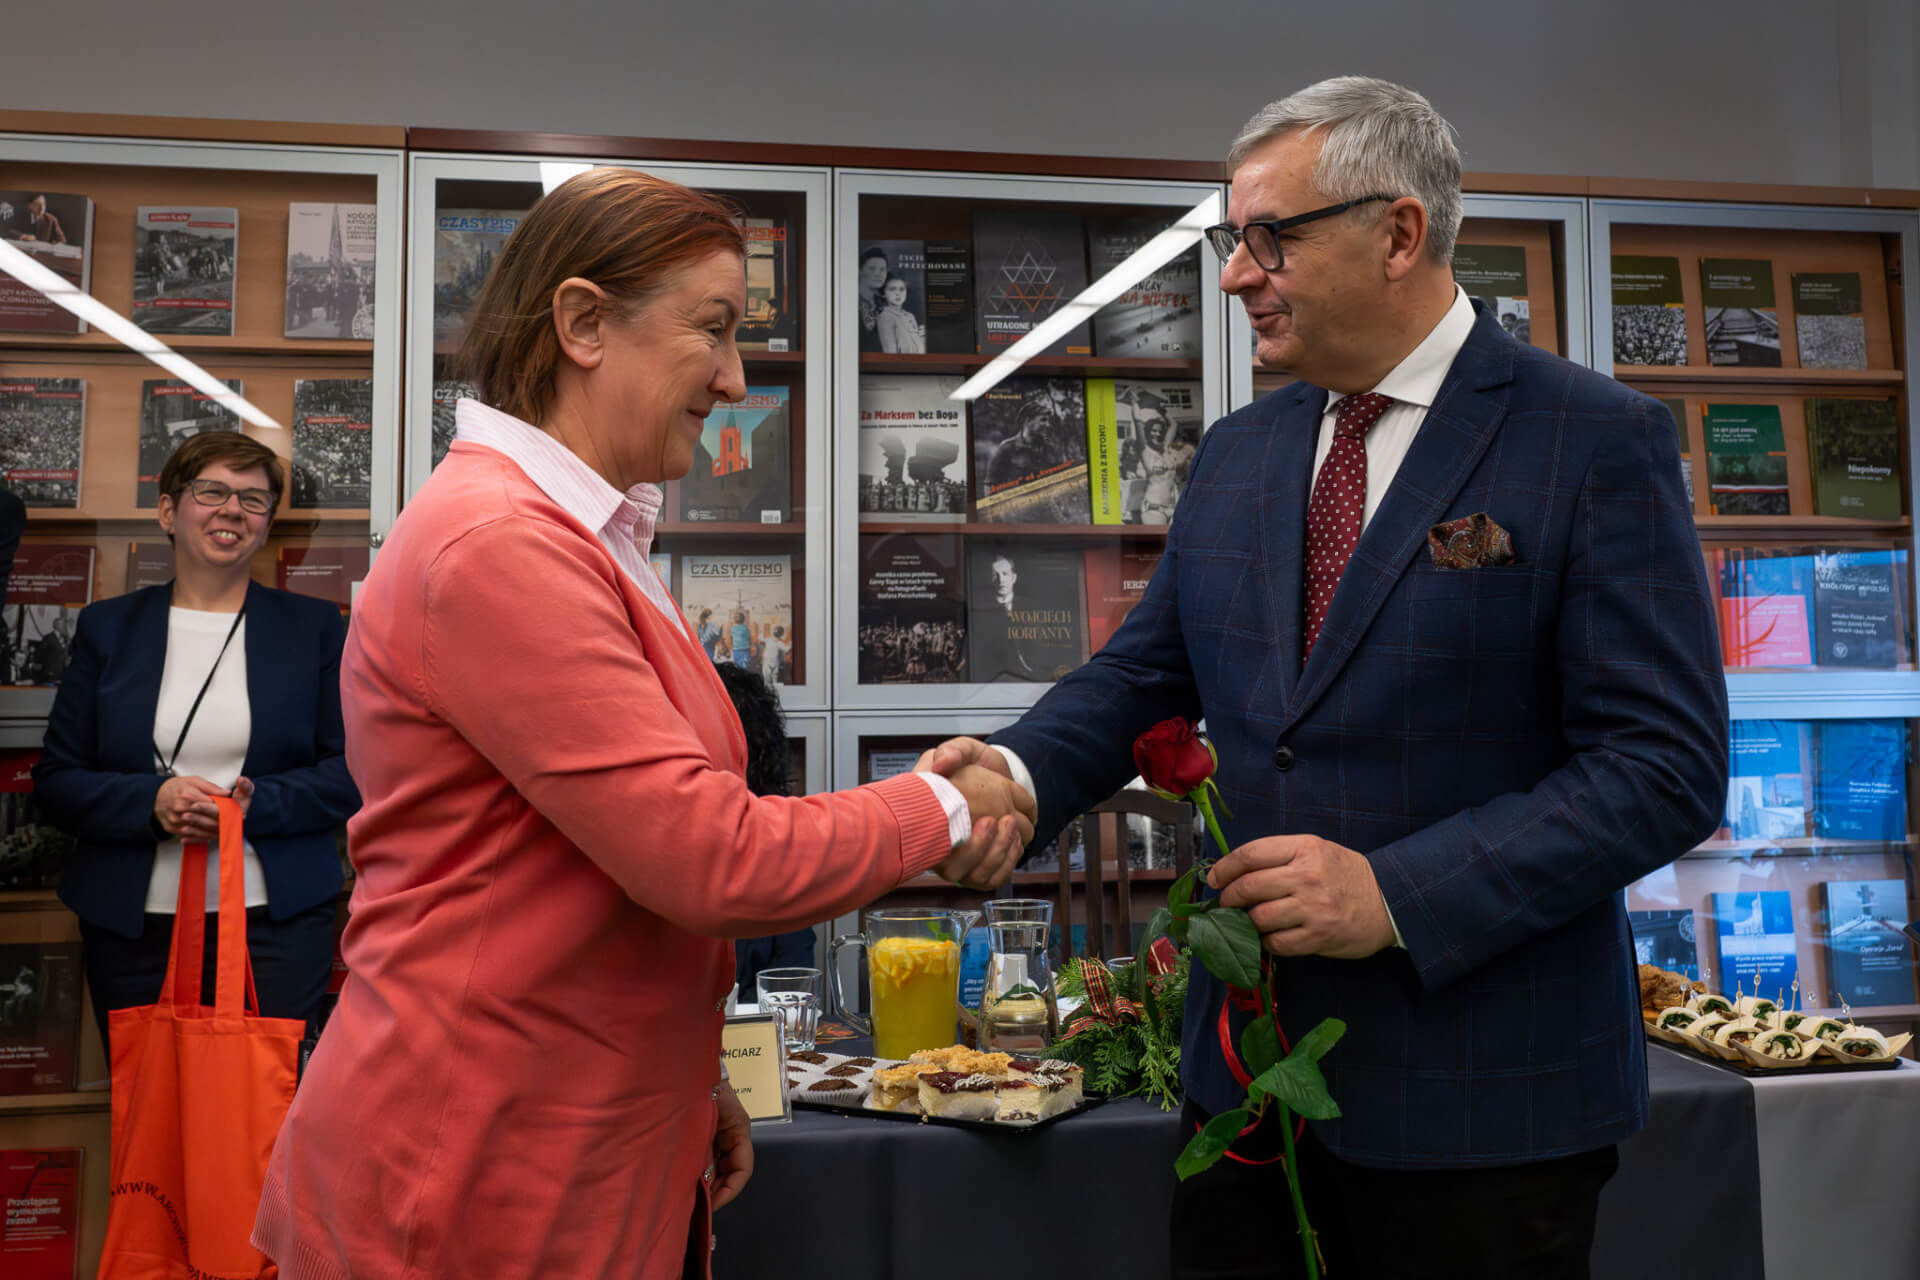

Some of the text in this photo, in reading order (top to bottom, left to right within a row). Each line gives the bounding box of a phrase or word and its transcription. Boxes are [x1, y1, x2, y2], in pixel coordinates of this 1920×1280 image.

[434, 389, 480, 400] CZAS
[738, 394, 780, 408] PISMO
[874, 409, 916, 421] Marksem
[918, 409, 934, 420] bez
[690, 563, 783, 578] CZASYPISMO
[1008, 609, 1072, 625] WOJCIECH
[1007, 625, 1072, 641] KORFANTY
[723, 1047, 762, 1059] HCIARZ
